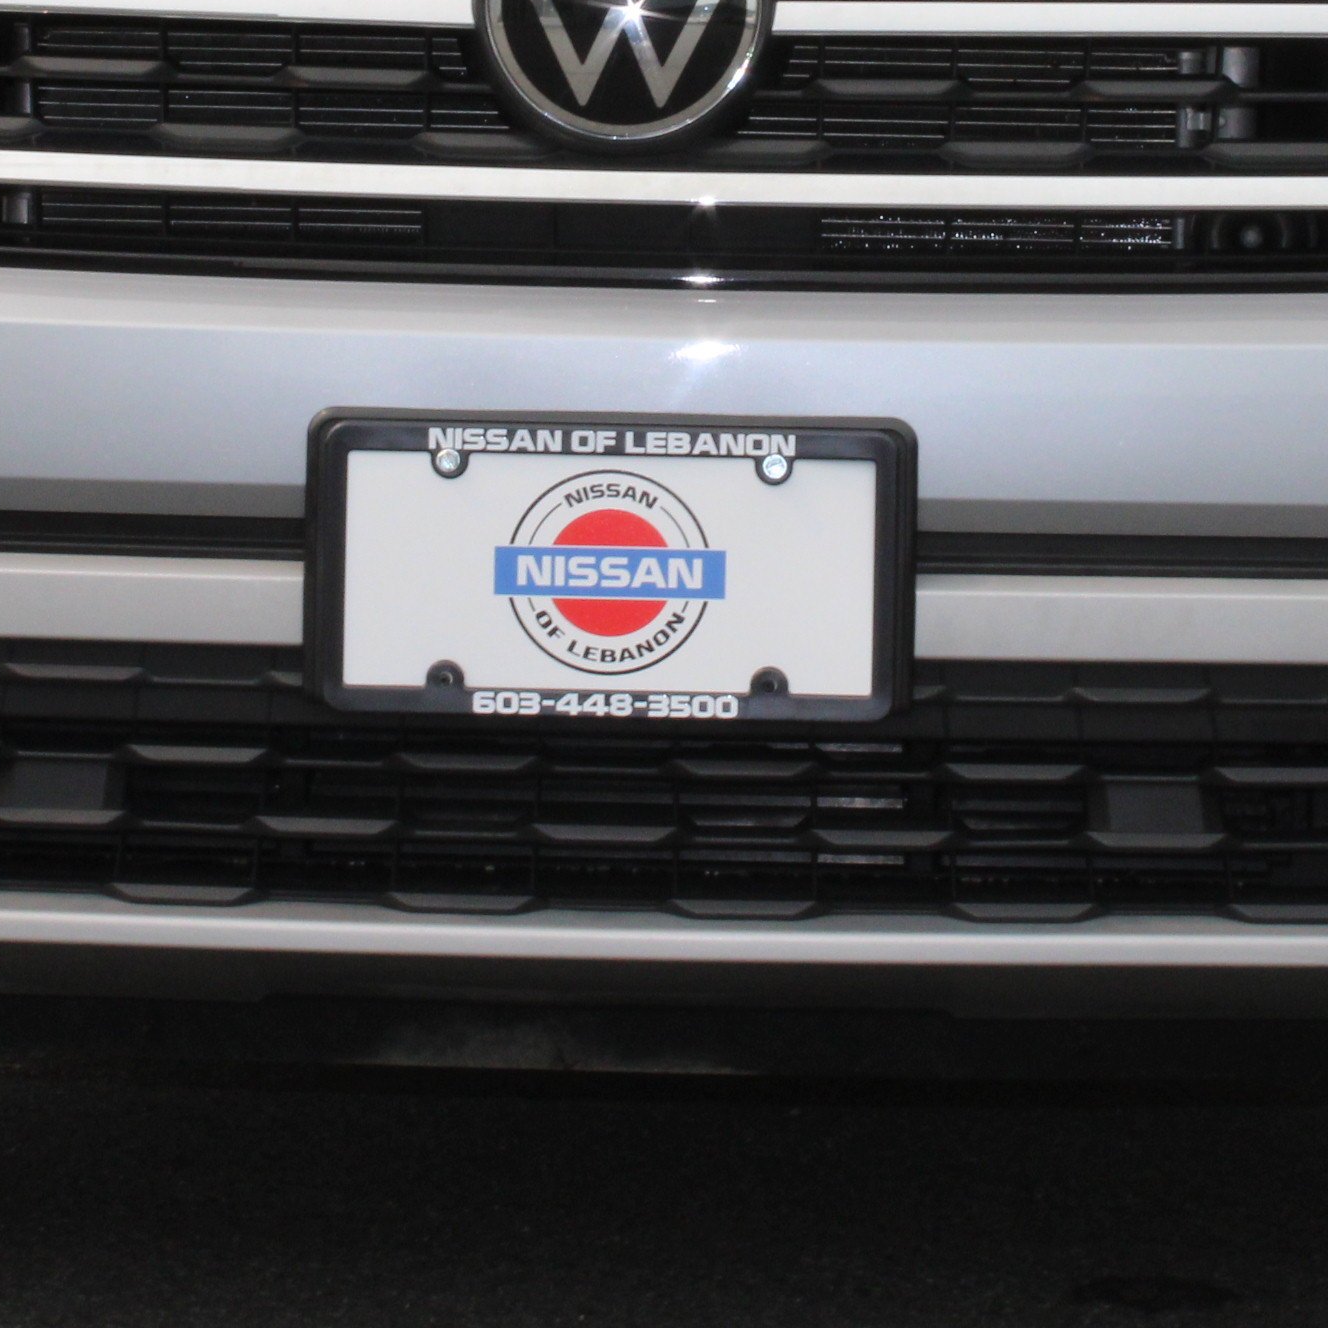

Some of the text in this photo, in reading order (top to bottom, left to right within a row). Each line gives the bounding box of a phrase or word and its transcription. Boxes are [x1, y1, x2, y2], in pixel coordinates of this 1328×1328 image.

[428, 427, 797, 457] NISSAN OF LEBANON
[563, 482, 659, 510] NISSAN
[515, 554, 704, 590] NISSAN
[535, 609, 686, 664] OF LEBANON
[472, 690, 739, 719] 603-448-3500
